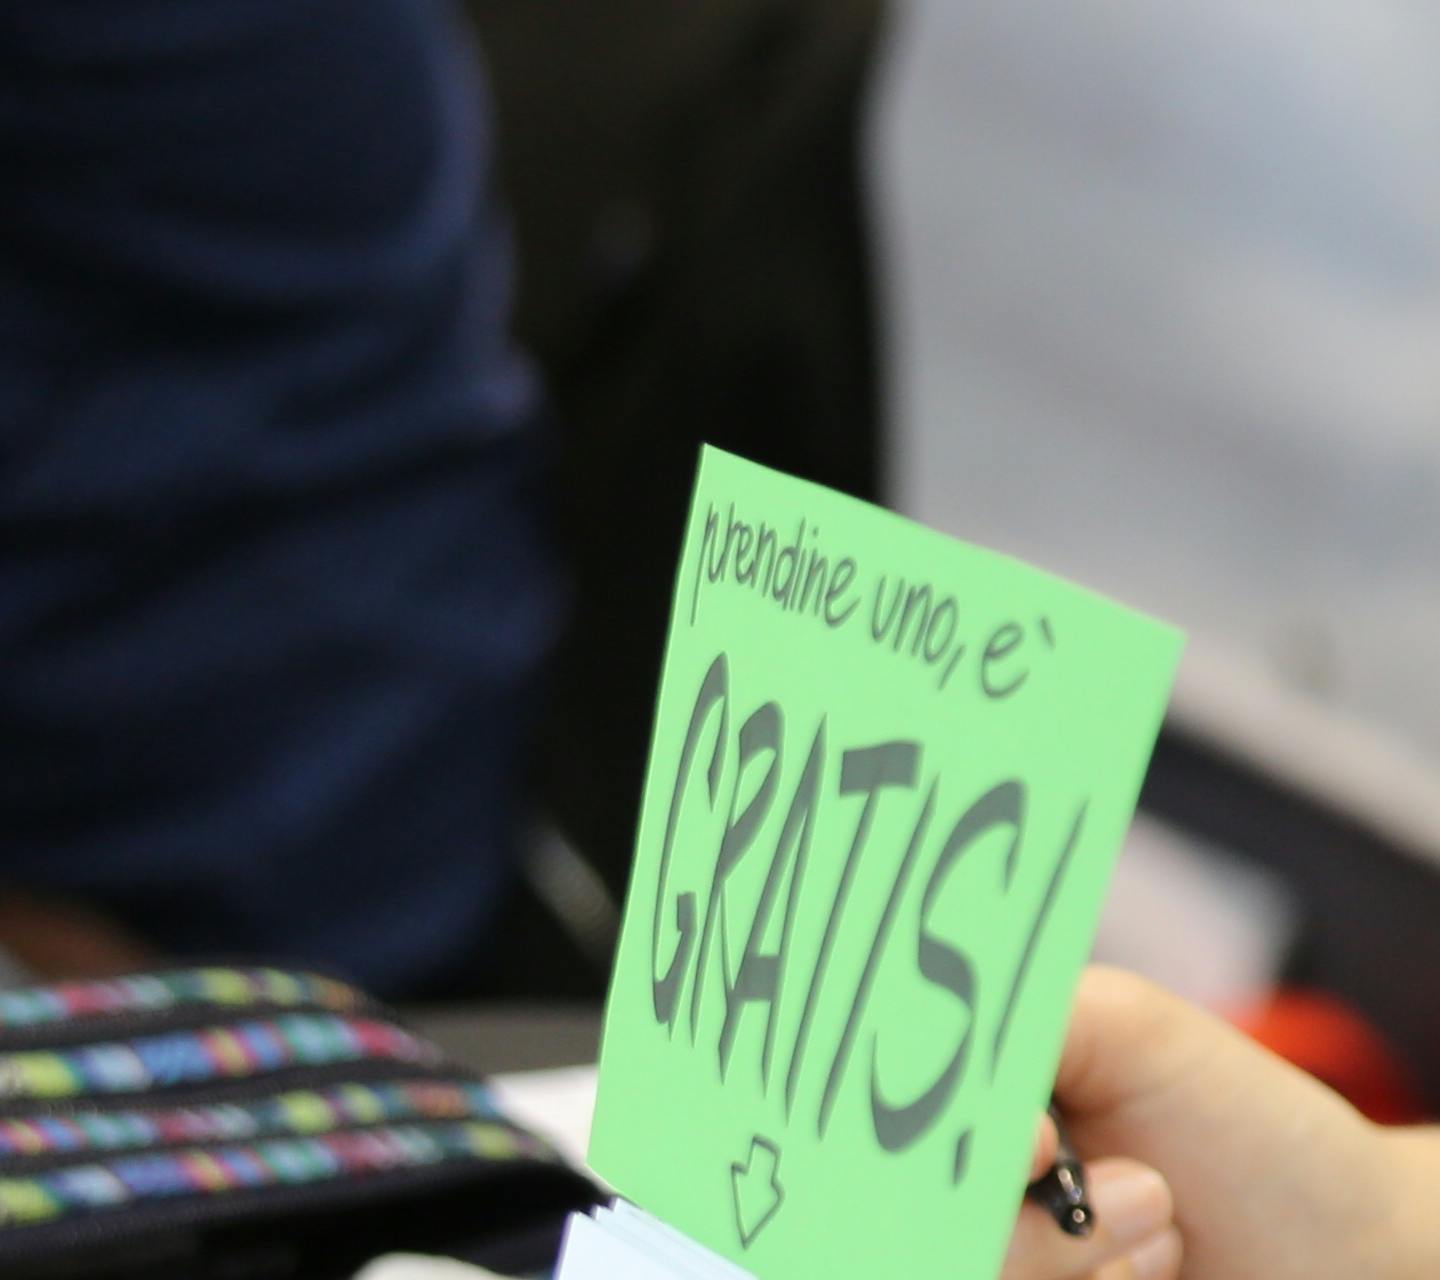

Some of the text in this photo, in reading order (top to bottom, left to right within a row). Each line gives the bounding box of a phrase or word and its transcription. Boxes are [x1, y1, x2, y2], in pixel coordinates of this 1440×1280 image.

[689, 500, 861, 629] prendine
[871, 573, 966, 691] uno,
[651, 650, 1091, 1188] GRATIS!
